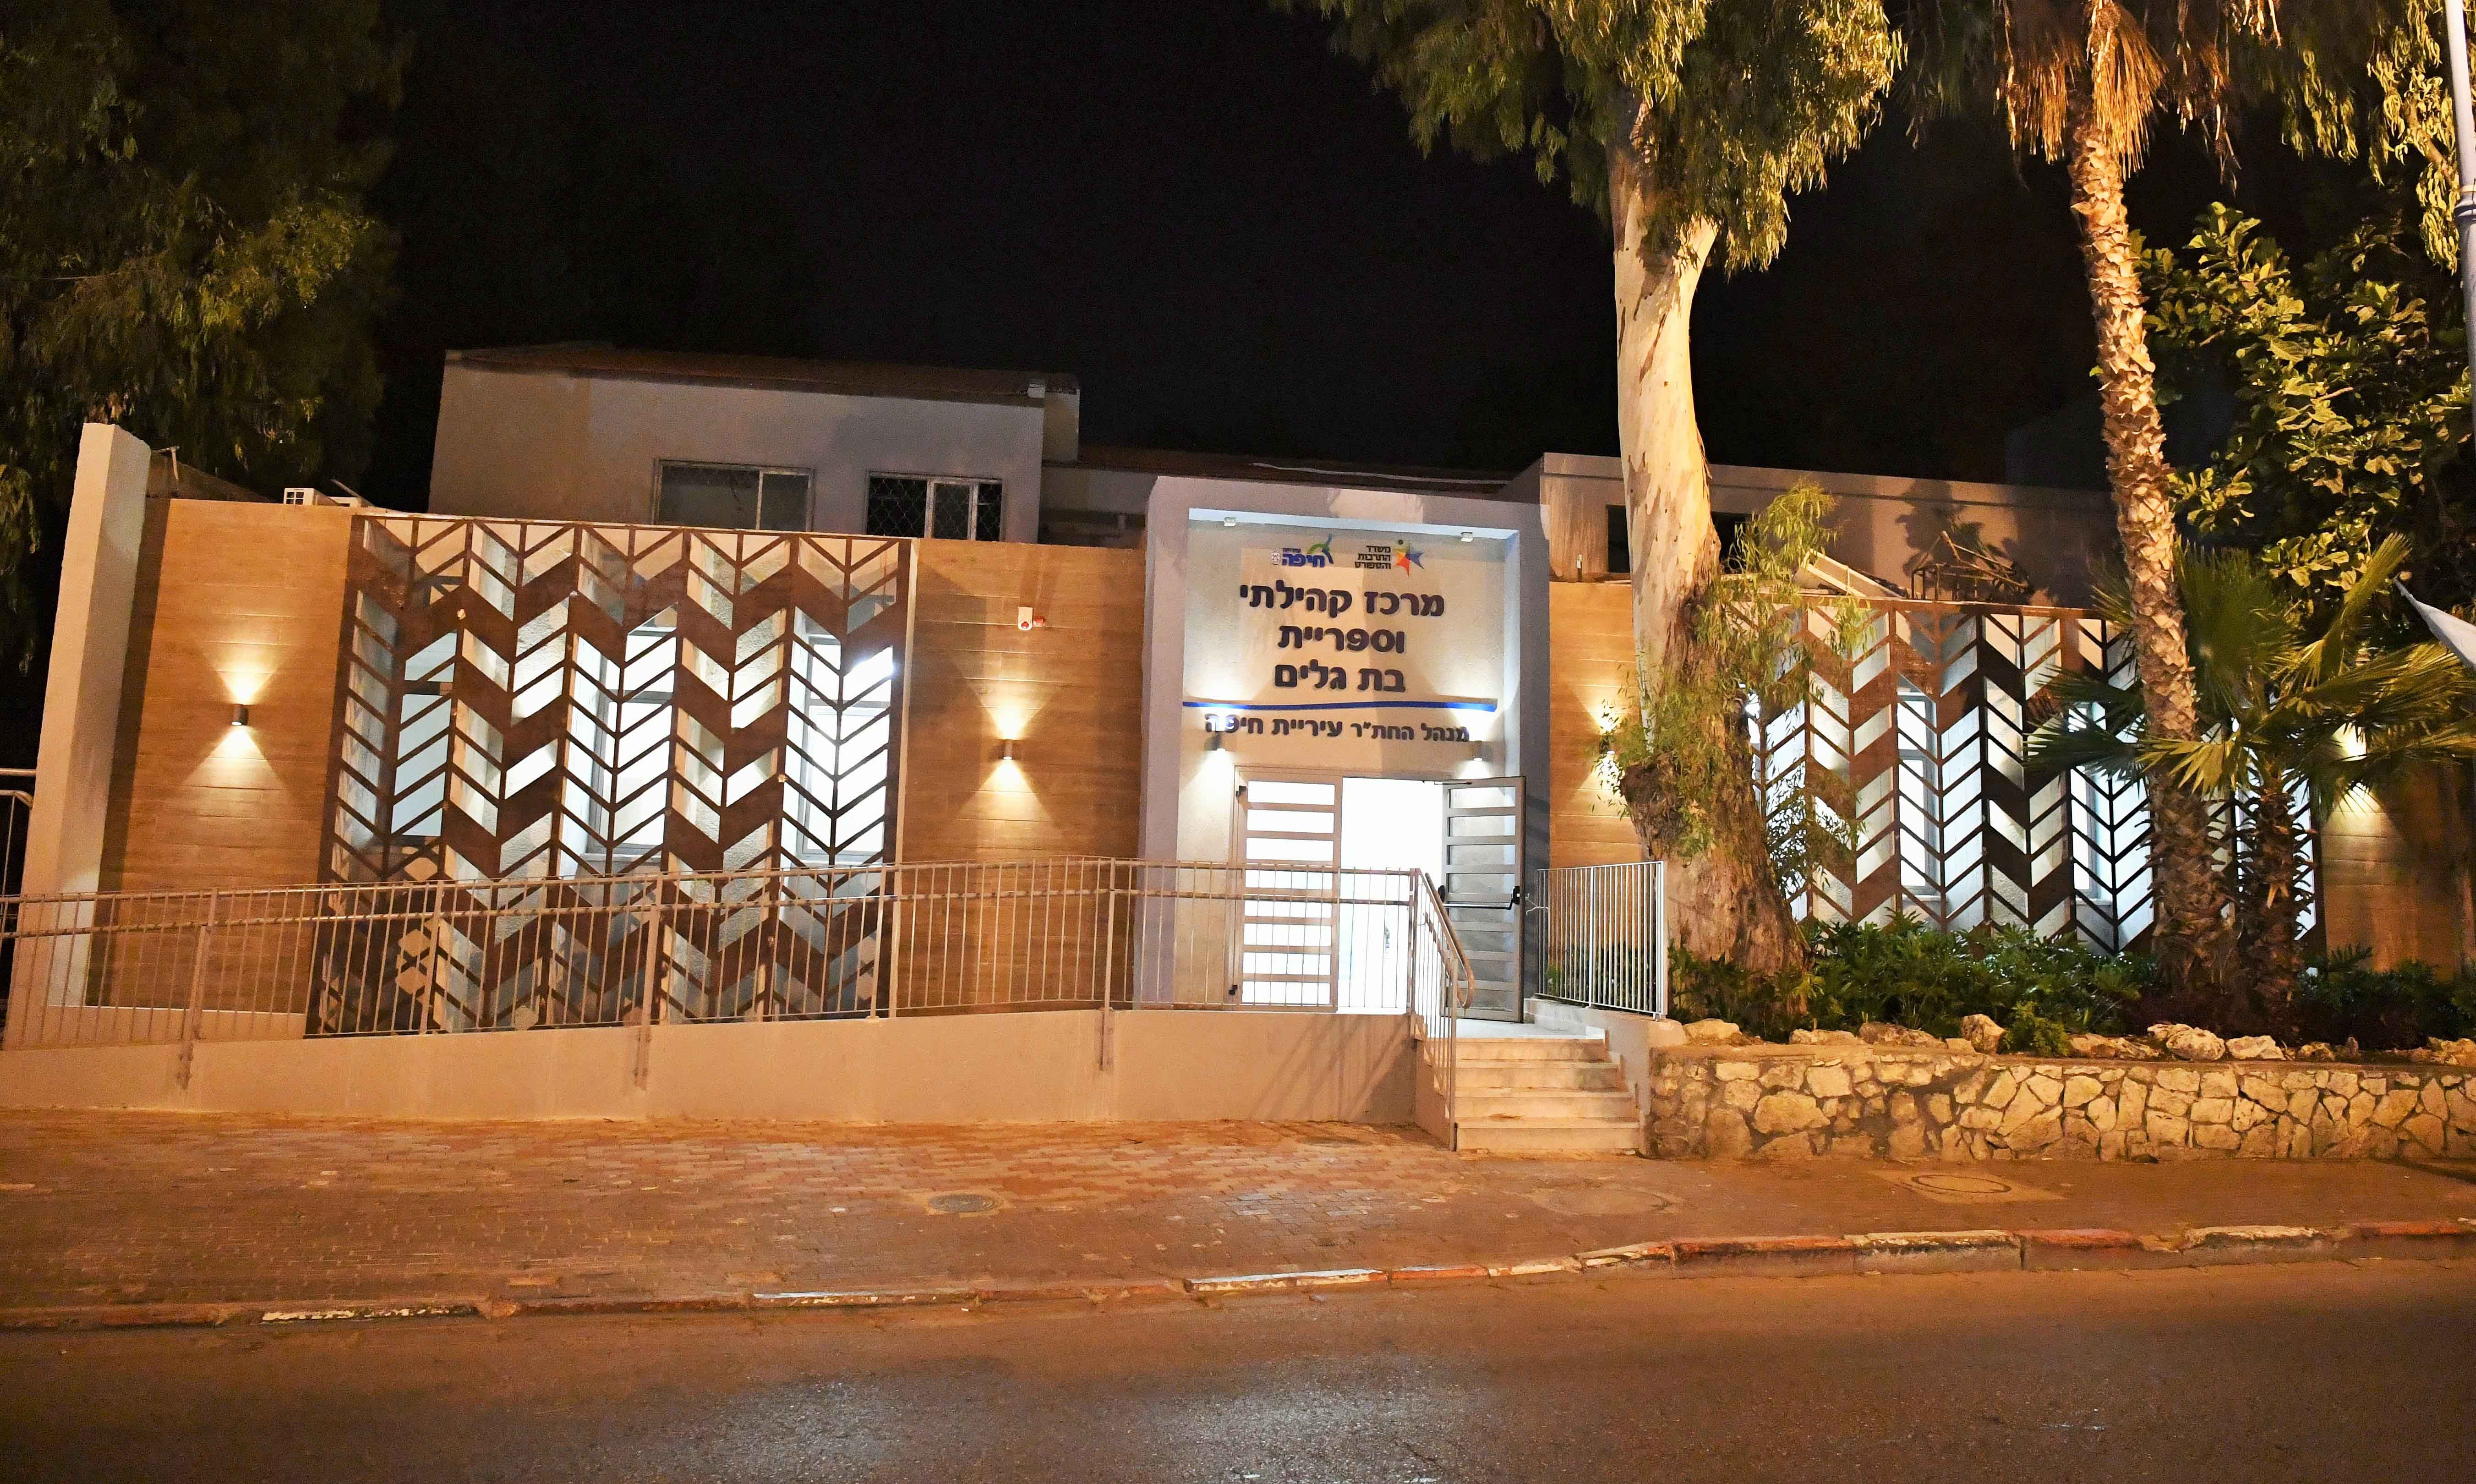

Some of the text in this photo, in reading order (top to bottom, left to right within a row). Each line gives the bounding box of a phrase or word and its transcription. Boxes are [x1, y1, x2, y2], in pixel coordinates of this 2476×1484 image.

[1282, 553, 1325, 567] חיפה
[1354, 561, 1391, 569] והספורט
[1357, 553, 1391, 562] התרבות
[1240, 579, 1444, 618] מרכז קהילתי
[1278, 625, 1405, 654] וספריית
[1275, 659, 1406, 693] בת גלים
[1271, 718, 1342, 737] עיריית
[1421, 723, 1470, 742] מנהל
